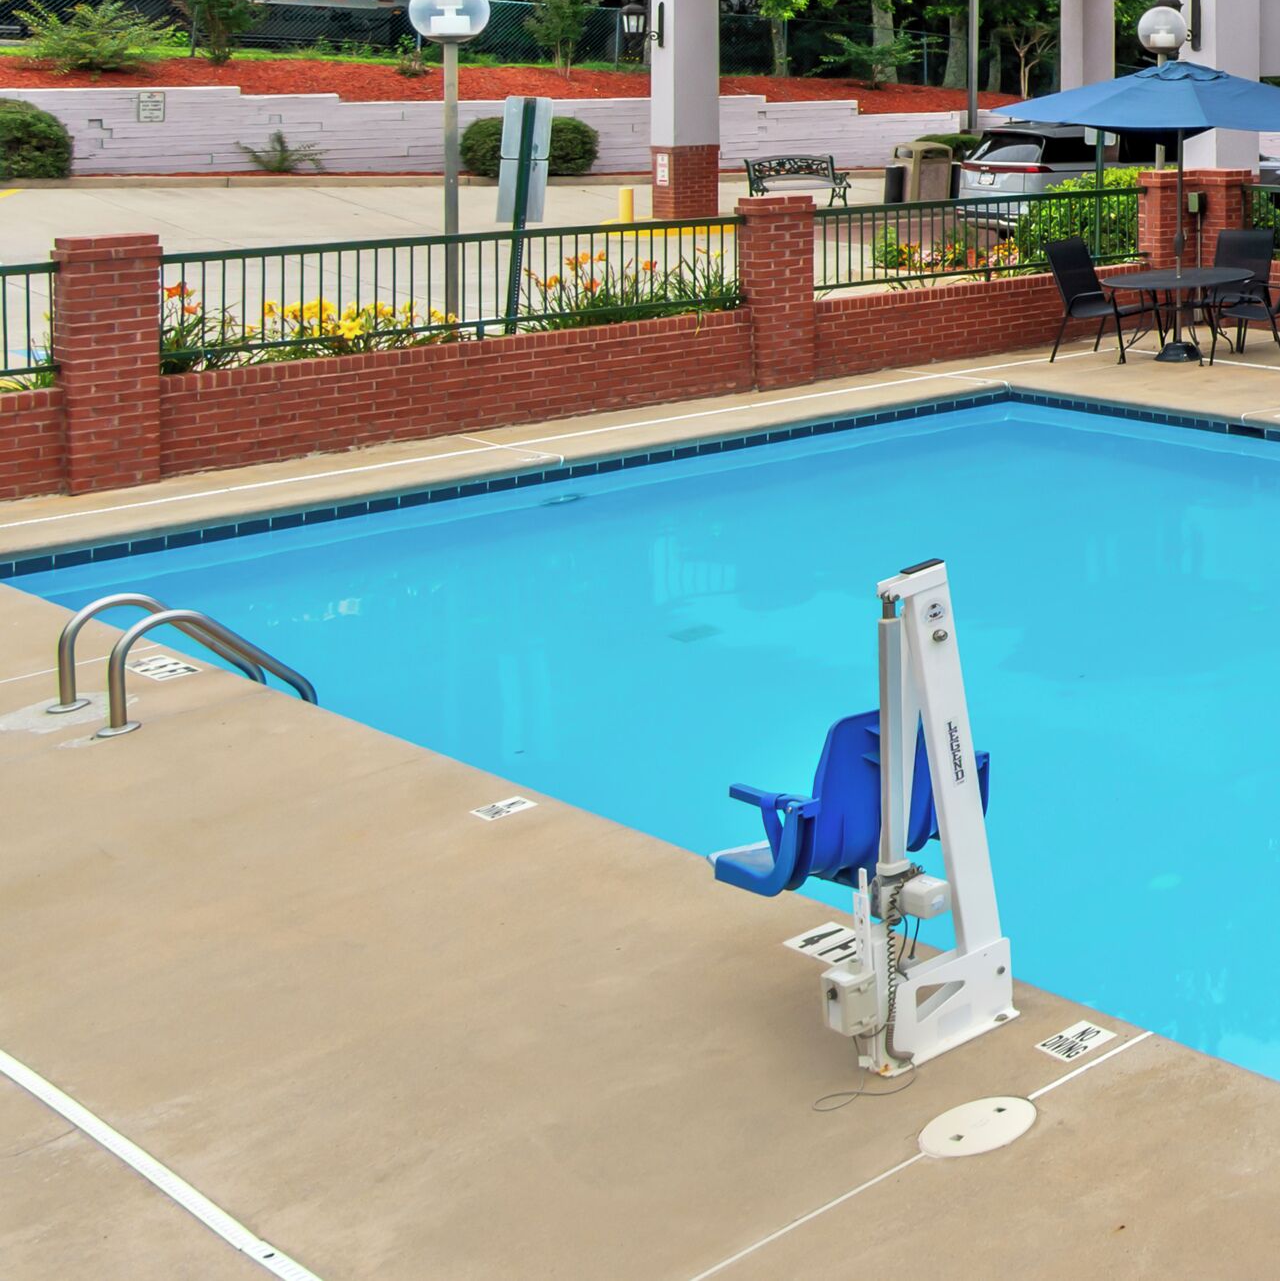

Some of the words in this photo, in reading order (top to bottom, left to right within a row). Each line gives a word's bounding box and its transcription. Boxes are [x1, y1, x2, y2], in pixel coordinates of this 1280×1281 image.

[947, 721, 965, 782] LEGEND
[798, 927, 844, 949] 4
[1072, 1026, 1101, 1042] NO
[1040, 1034, 1088, 1059] DIVING
